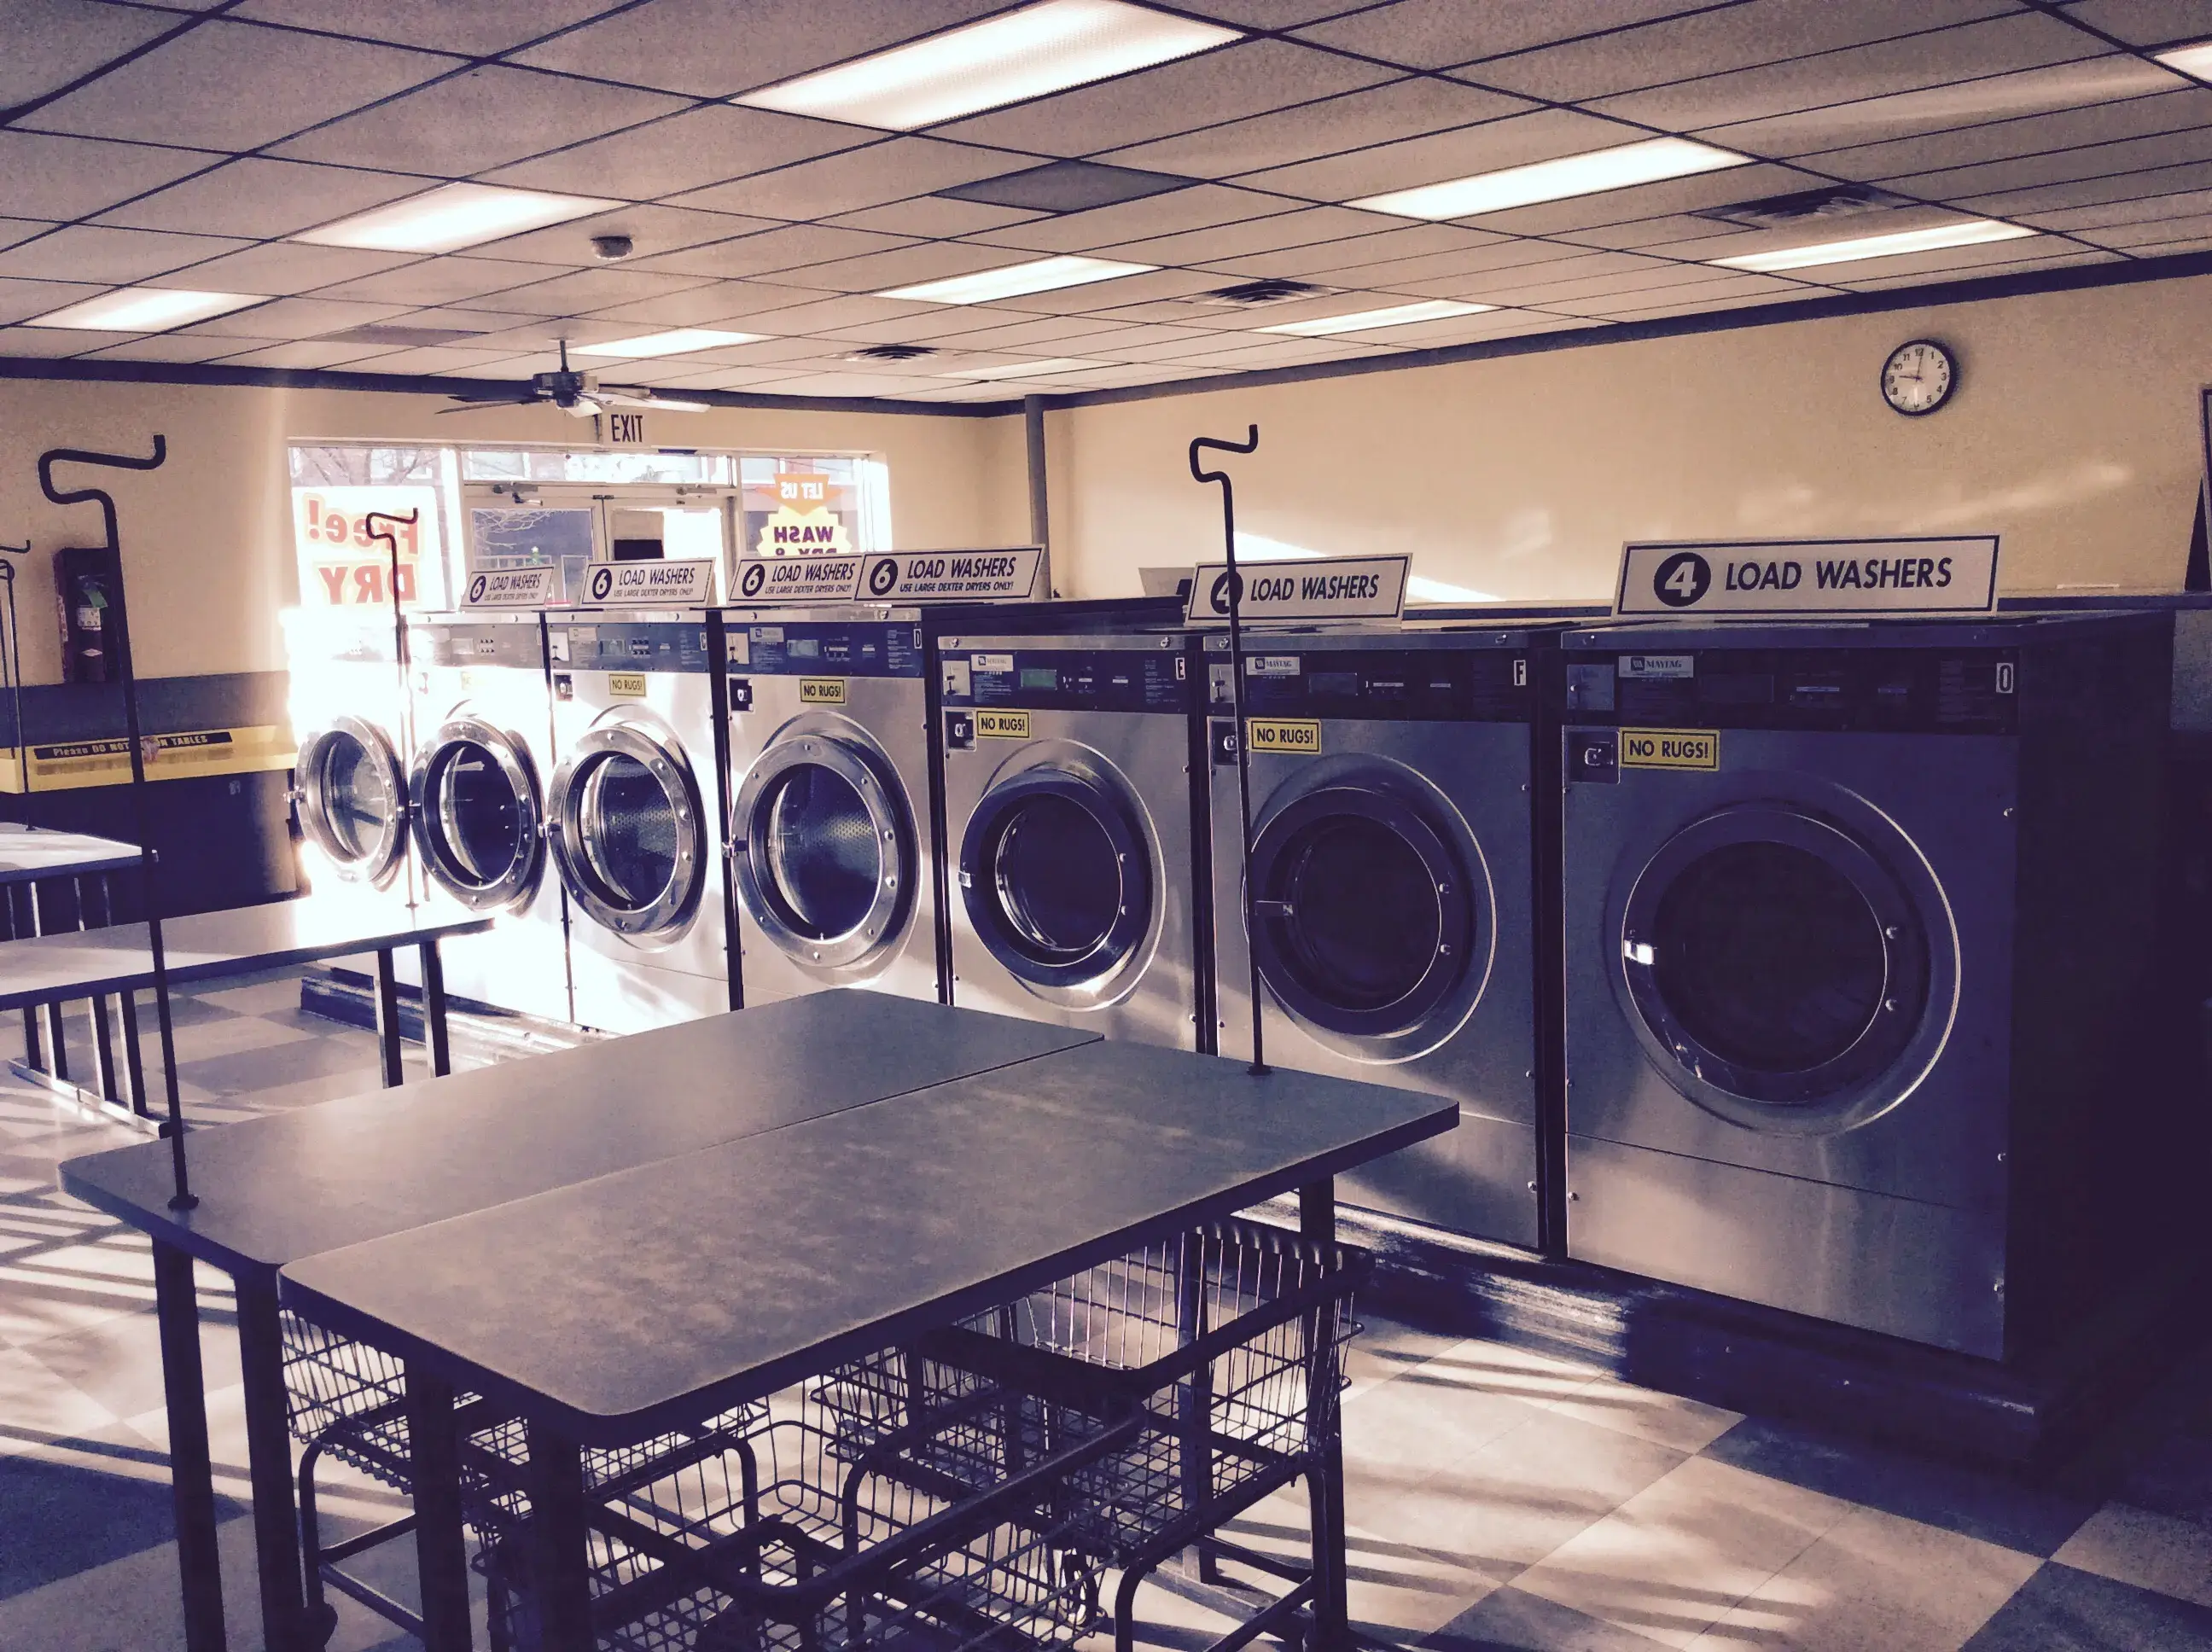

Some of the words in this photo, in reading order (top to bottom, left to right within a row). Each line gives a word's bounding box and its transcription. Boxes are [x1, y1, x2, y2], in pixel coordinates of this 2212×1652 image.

[1941, 372, 1947, 381] 3
[1936, 385, 1942, 393] 4
[1902, 396, 1906, 404] 7
[611, 414, 643, 442] EXIT
[619, 569, 645, 585] LOAD
[649, 567, 696, 585] WASHERS
[771, 565, 801, 582] LOAD
[805, 563, 855, 581] WASHERS
[872, 561, 894, 592] 6
[907, 560, 945, 579] LOAD
[951, 556, 1016, 578] WASHERS
[1658, 555, 1703, 602] 4
[1725, 561, 1802, 590] LOAD
[1815, 557, 1953, 590] WASHERS
[490, 575, 509, 590] LOAD
[510, 573, 542, 590] WASHERS
[899, 584, 911, 592] USE
[915, 583, 935, 592] LARGE
[937, 582, 963, 591] DEXTER
[965, 582, 991, 590] DRYERS
[1250, 578, 1295, 602] LOAD
[1301, 573, 1380, 600] WASHERS
[915, 630, 921, 647] D
[1177, 659, 1185, 678] E
[1646, 659, 1682, 669] MAYTAG
[1516, 662, 1525, 684] F
[612, 679, 623, 689] NO
[625, 680, 643, 691] RUGS!
[804, 685, 816, 696] NO
[818, 686, 841, 697] RUGS!
[981, 718, 995, 730] NO
[998, 718, 1026, 731] RUGS!
[172, 735, 208, 746] TABLES
[1256, 728, 1276, 743] NO
[1279, 729, 1313, 744] RUGS!
[1629, 739, 1655, 758] NO
[1661, 741, 1708, 759] RUGS!
